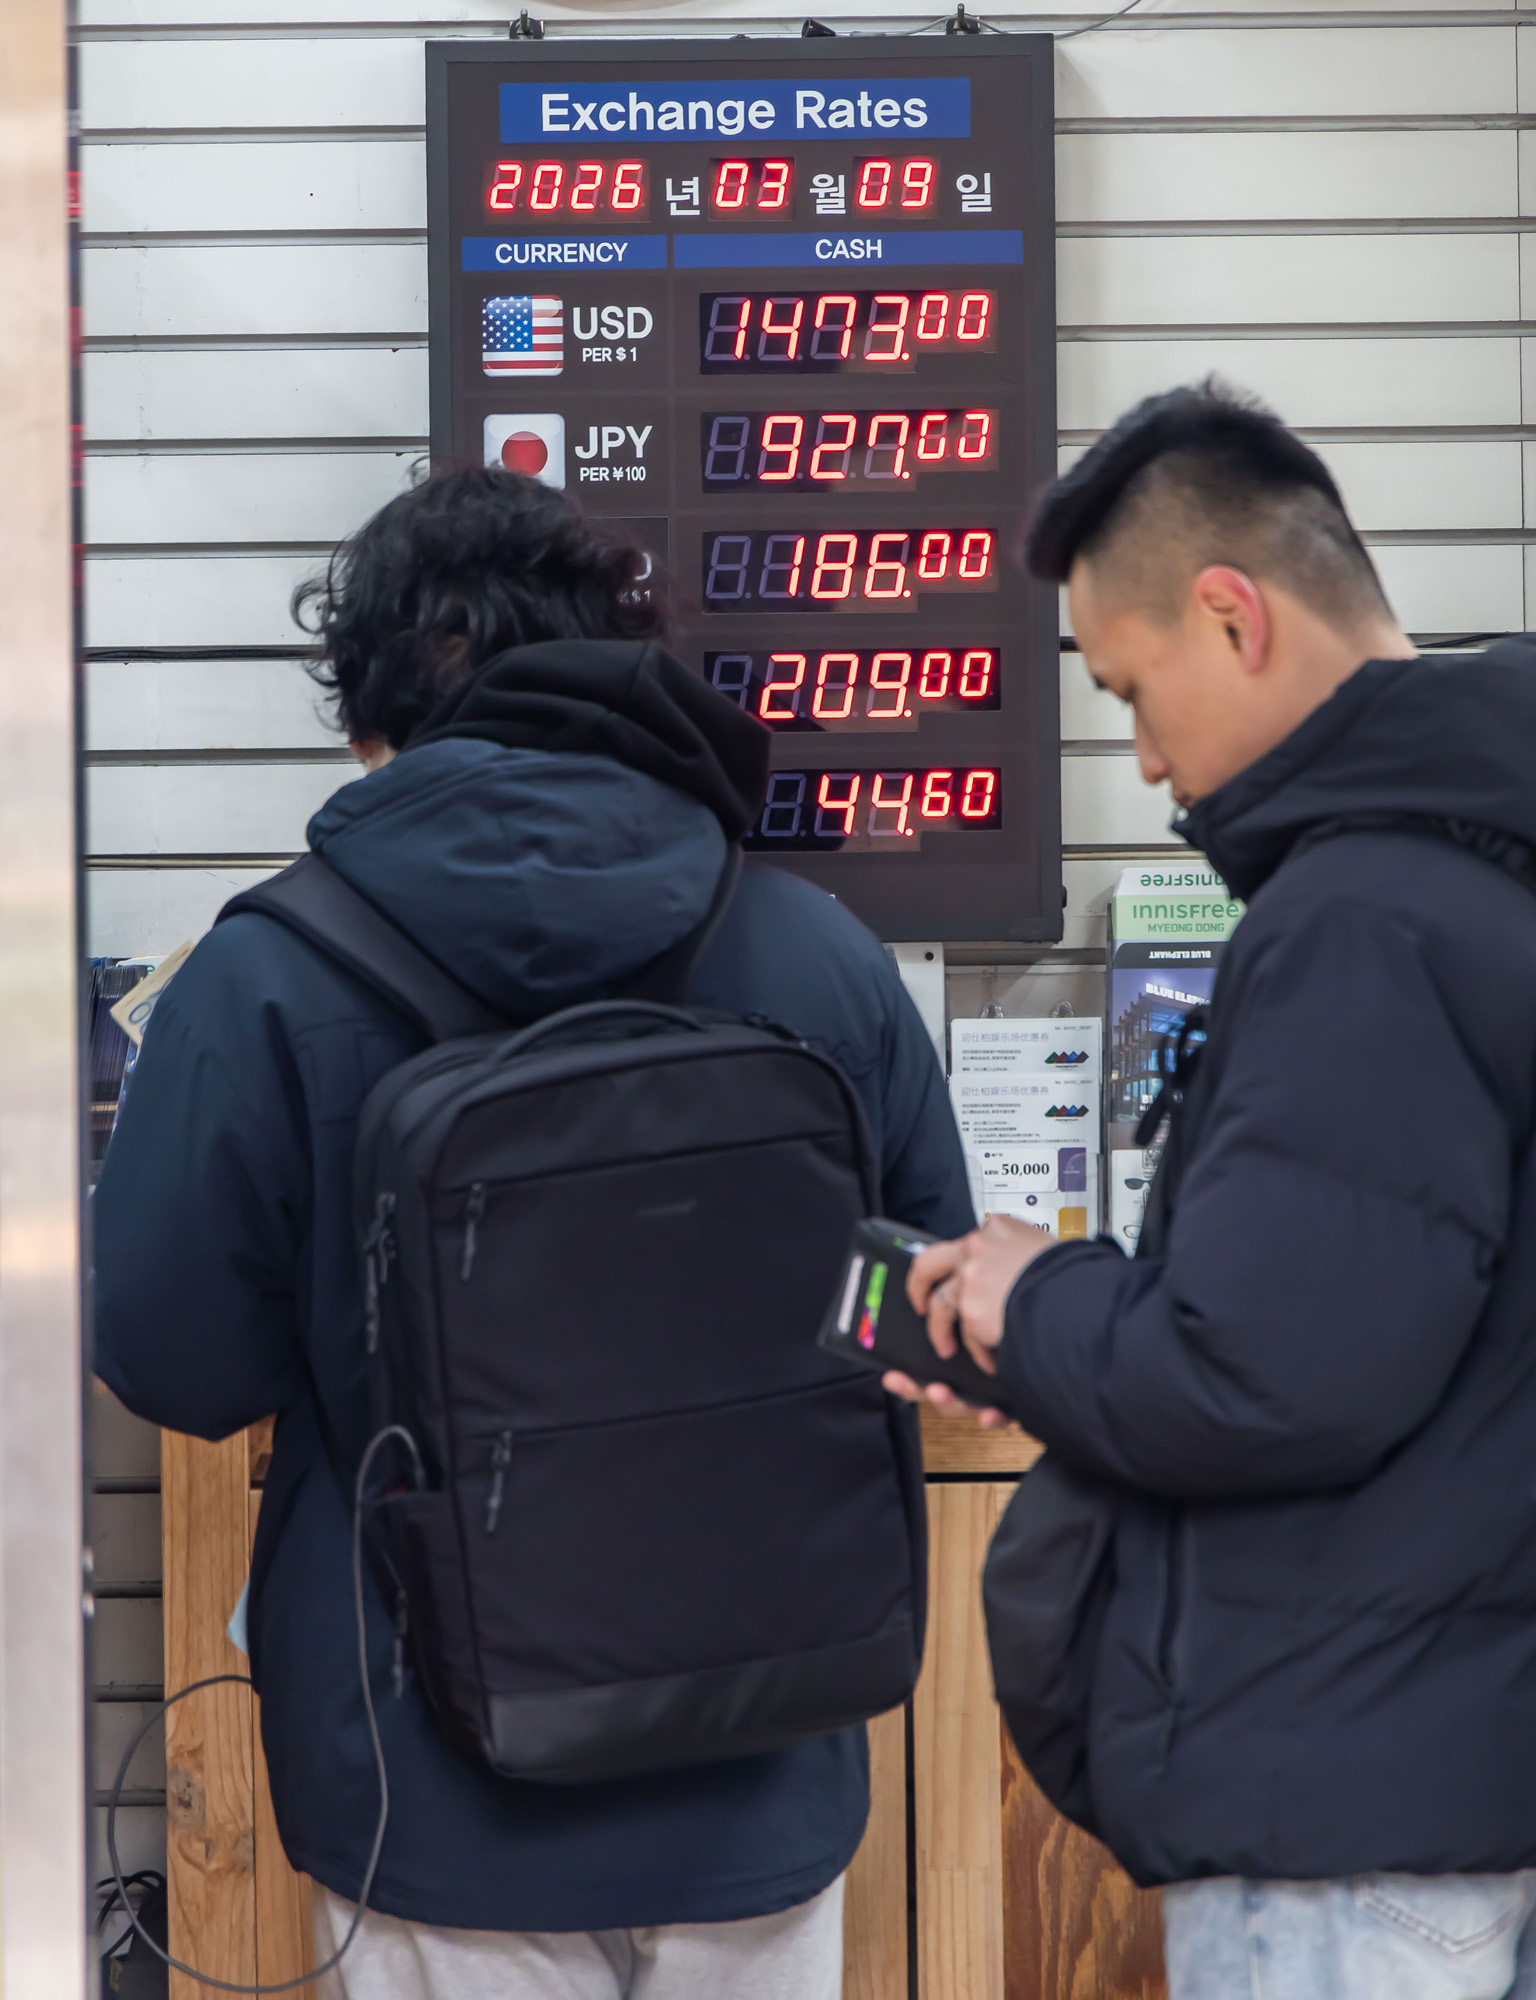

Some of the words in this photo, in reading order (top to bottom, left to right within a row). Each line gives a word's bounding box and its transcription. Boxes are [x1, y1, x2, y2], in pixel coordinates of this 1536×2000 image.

[541, 91, 776, 136] Exchange
[795, 89, 928, 130] Rates
[489, 161, 644, 211] 2026
[665, 176, 701, 216] 년
[714, 161, 791, 209] 03
[809, 173, 848, 215] 월
[857, 160, 935, 208] 09
[955, 171, 993, 214] 일
[494, 242, 629, 265] CURRENCY
[815, 238, 883, 260] CASH
[572, 305, 654, 341] USD
[582, 347, 613, 362] PER
[574, 425, 653, 460] JPY
[579, 466, 610, 482] PER
[1147, 923, 1193, 932] MYEONG
[1195, 922, 1225, 932] DONG
[1190, 950, 1212, 959] BLUE
[1145, 983, 1174, 1000] BLUE
[1001, 1163, 1050, 1177] 50,000
